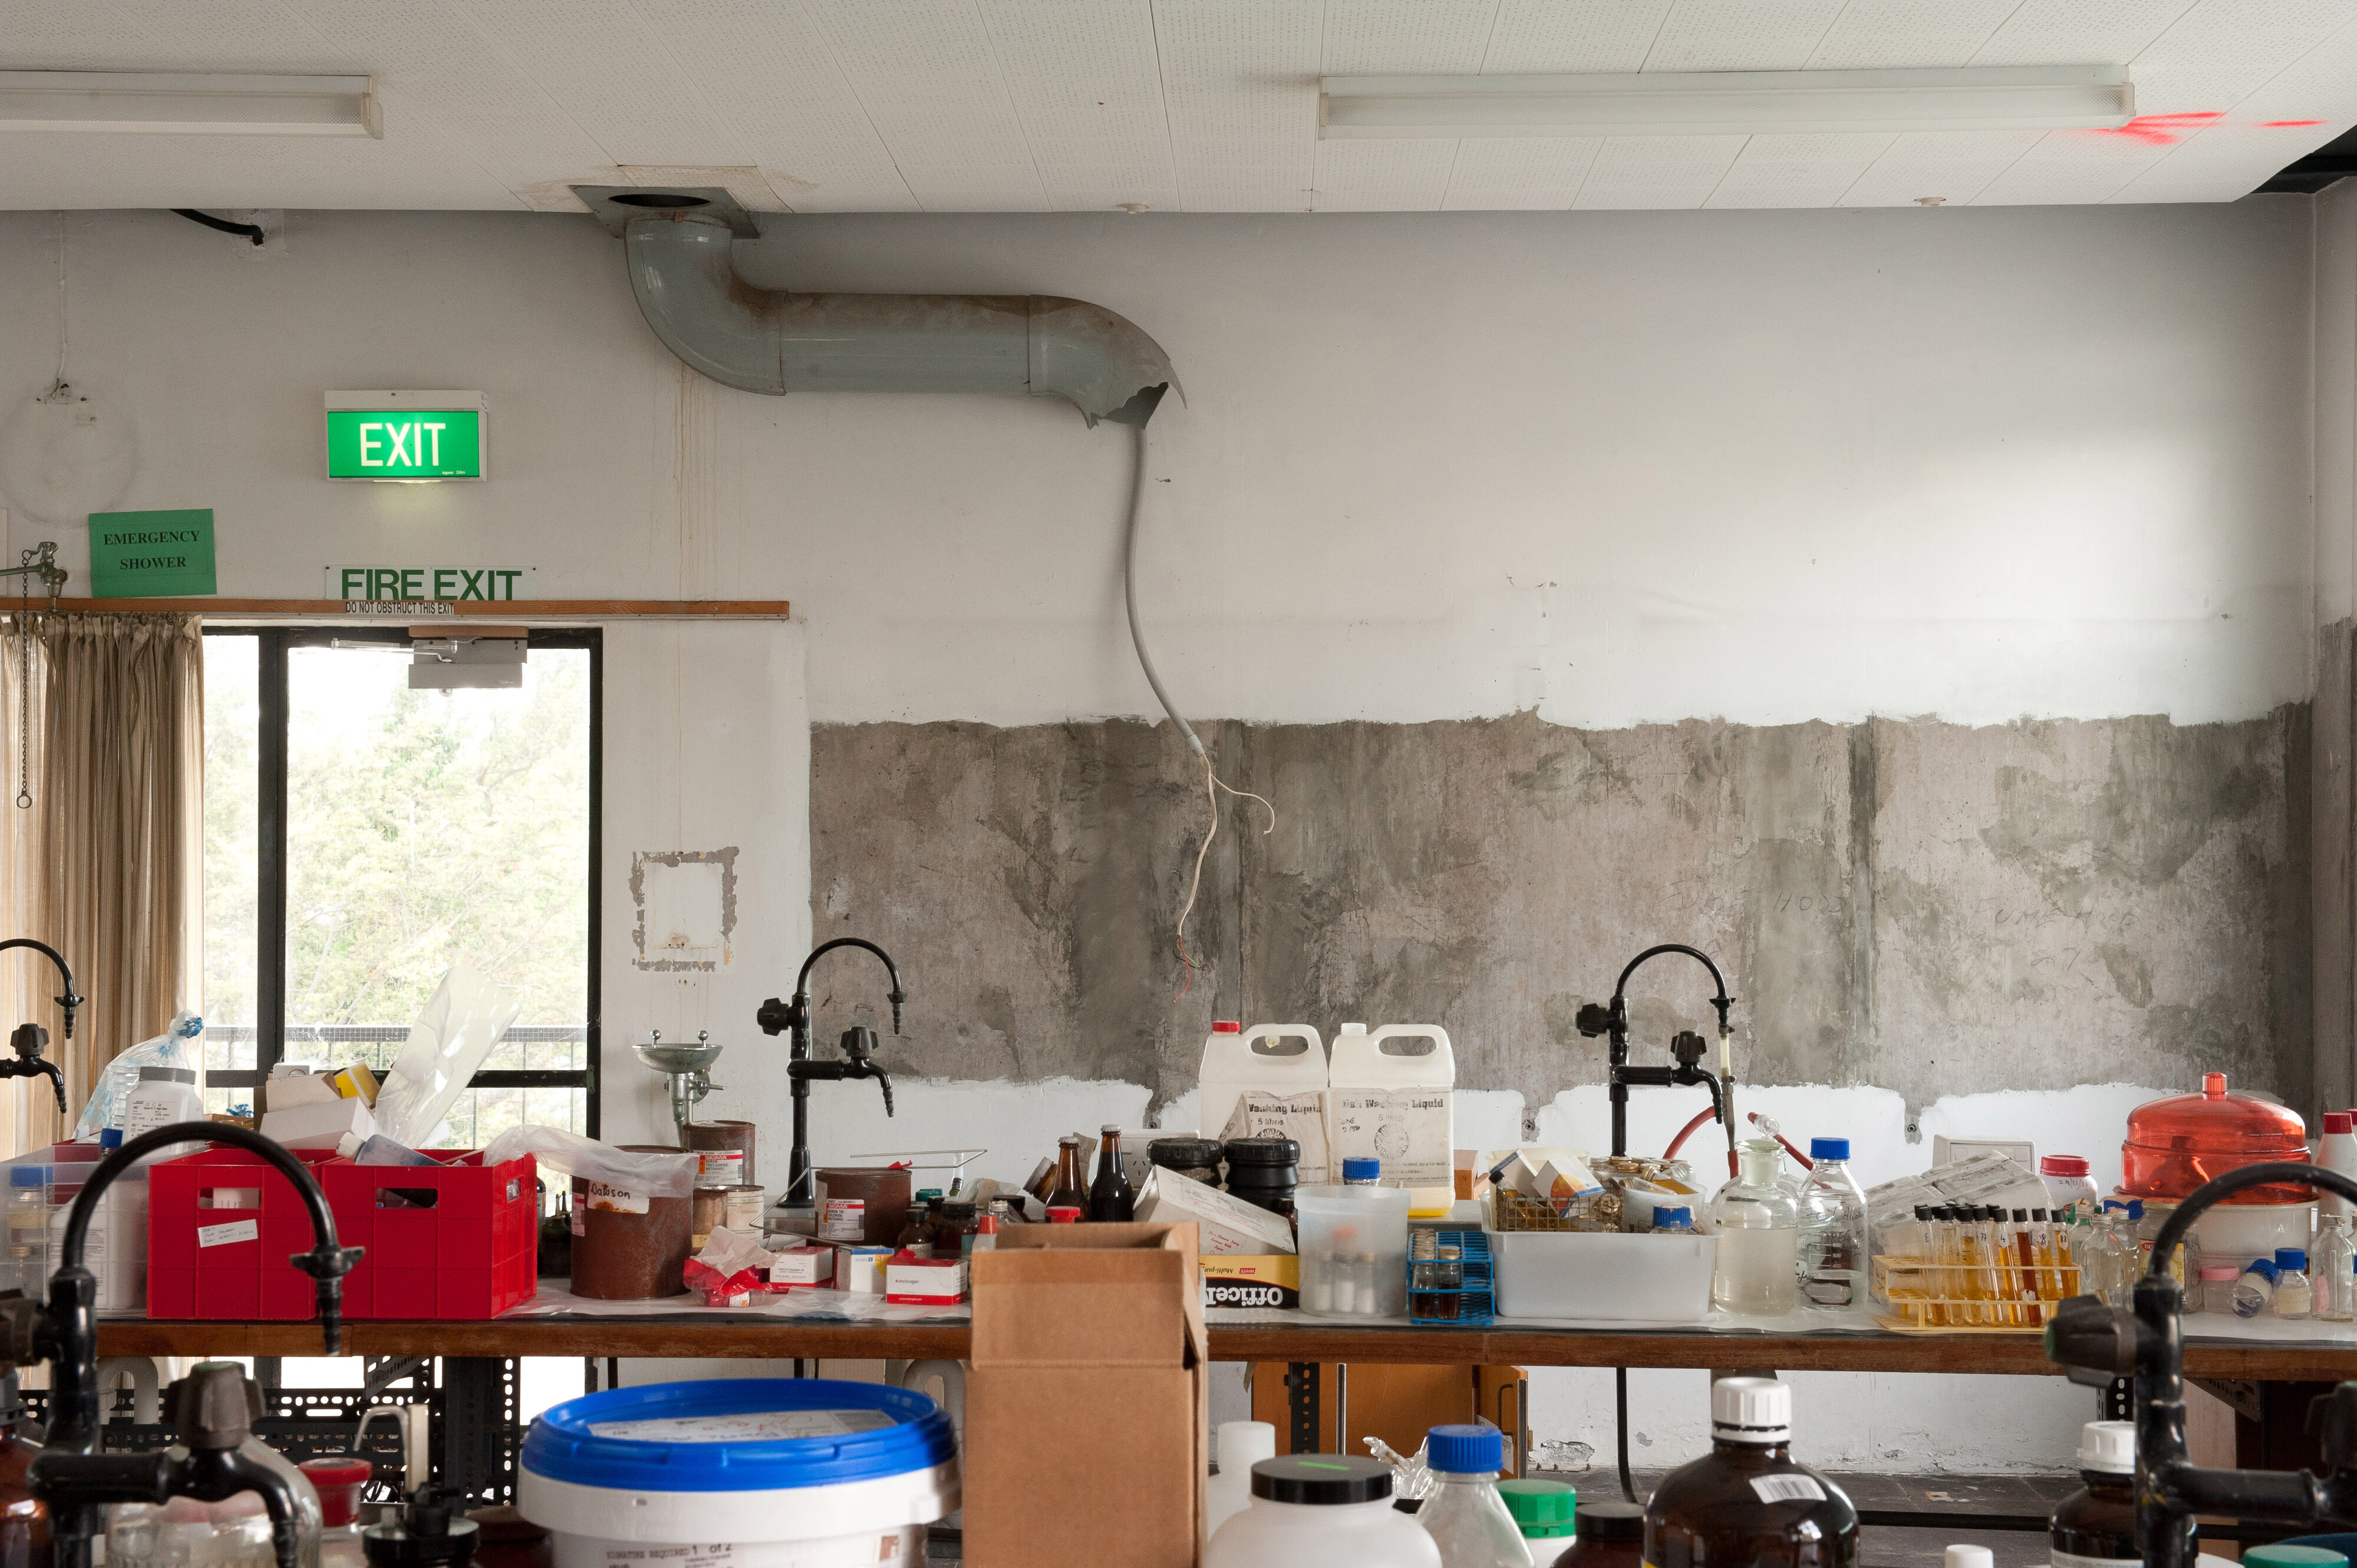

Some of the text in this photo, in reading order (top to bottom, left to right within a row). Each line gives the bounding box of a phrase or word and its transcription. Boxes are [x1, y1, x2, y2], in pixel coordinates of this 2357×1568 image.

[360, 422, 446, 467] EXIT
[103, 530, 200, 545] EMERGENCY
[120, 556, 187, 570] SHOWER
[342, 569, 523, 601] FIRE EXIT
[346, 602, 454, 615] DO NOT OBSTRUCT THIS EXIT
[1411, 1098, 1444, 1110] Liquid
[590, 1183, 630, 1200] Dawson
